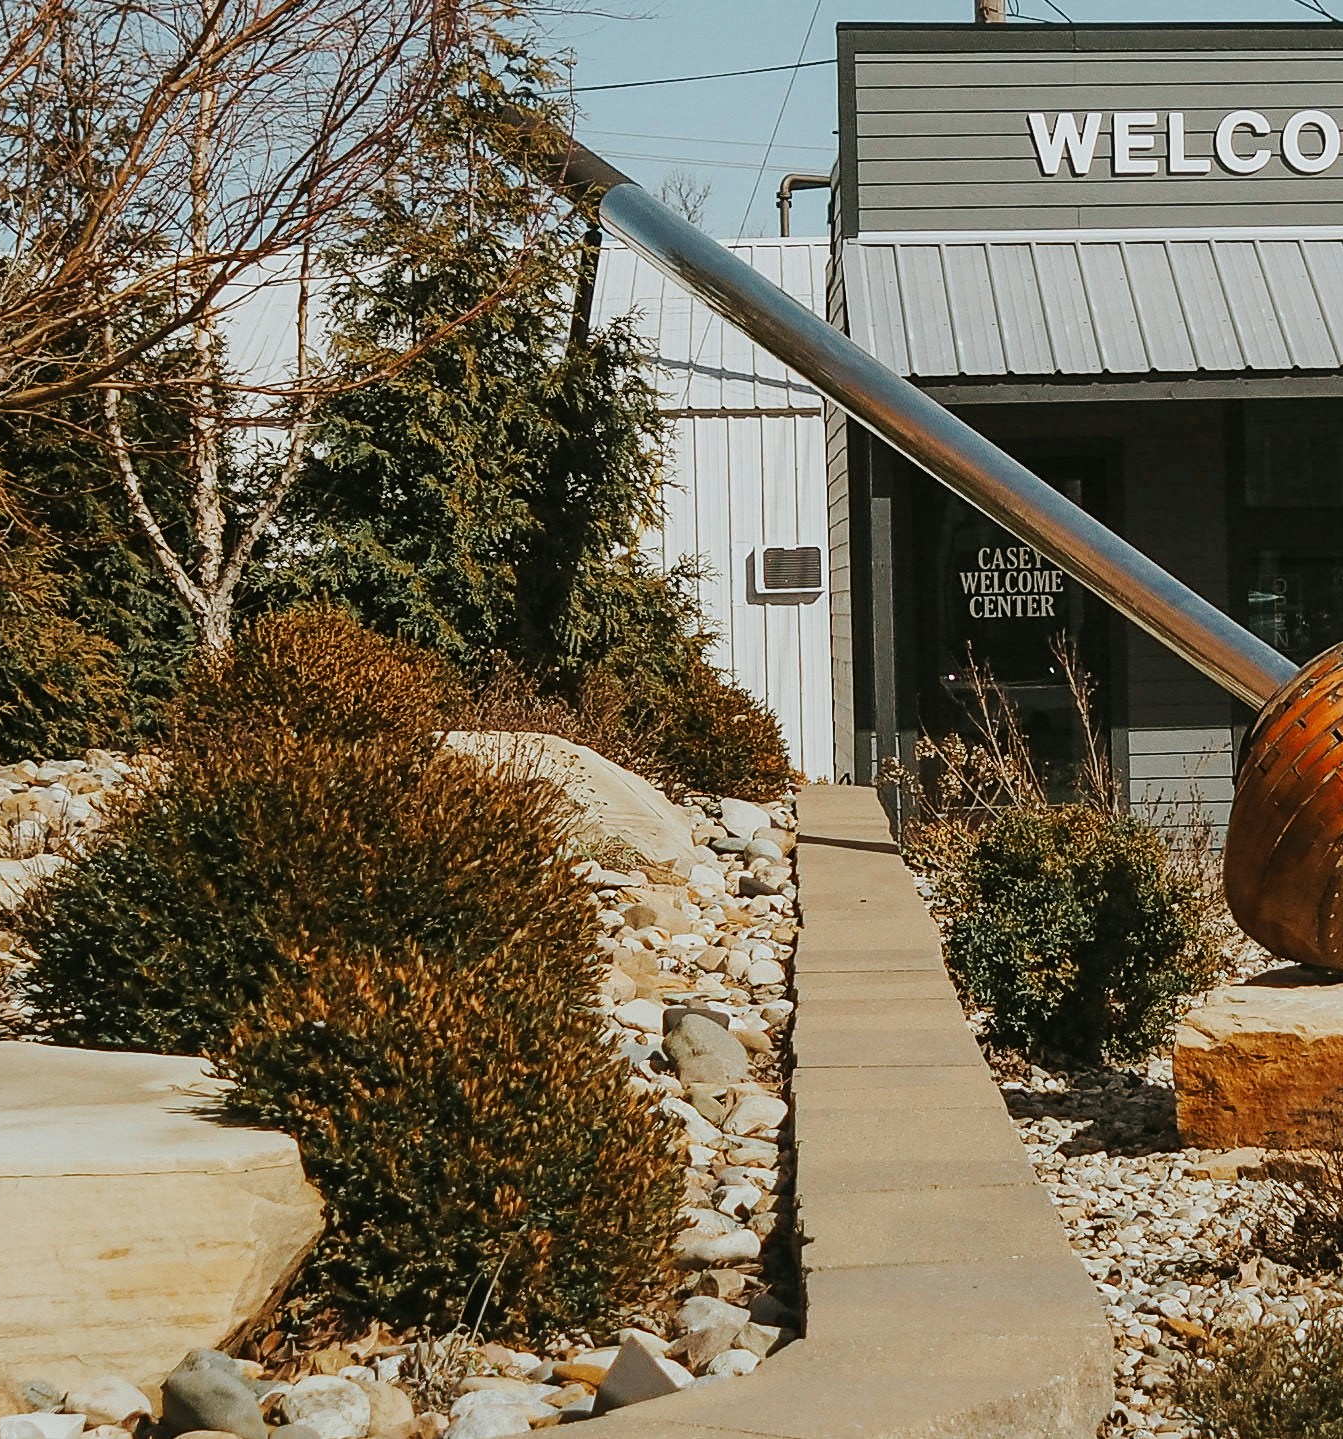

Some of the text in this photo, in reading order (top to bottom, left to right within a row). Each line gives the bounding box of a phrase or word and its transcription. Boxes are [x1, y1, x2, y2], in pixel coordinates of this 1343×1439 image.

[959, 570, 1064, 594] WELCOME
[969, 594, 1056, 618] CENTER
[1272, 577, 1289, 648] OPEN
